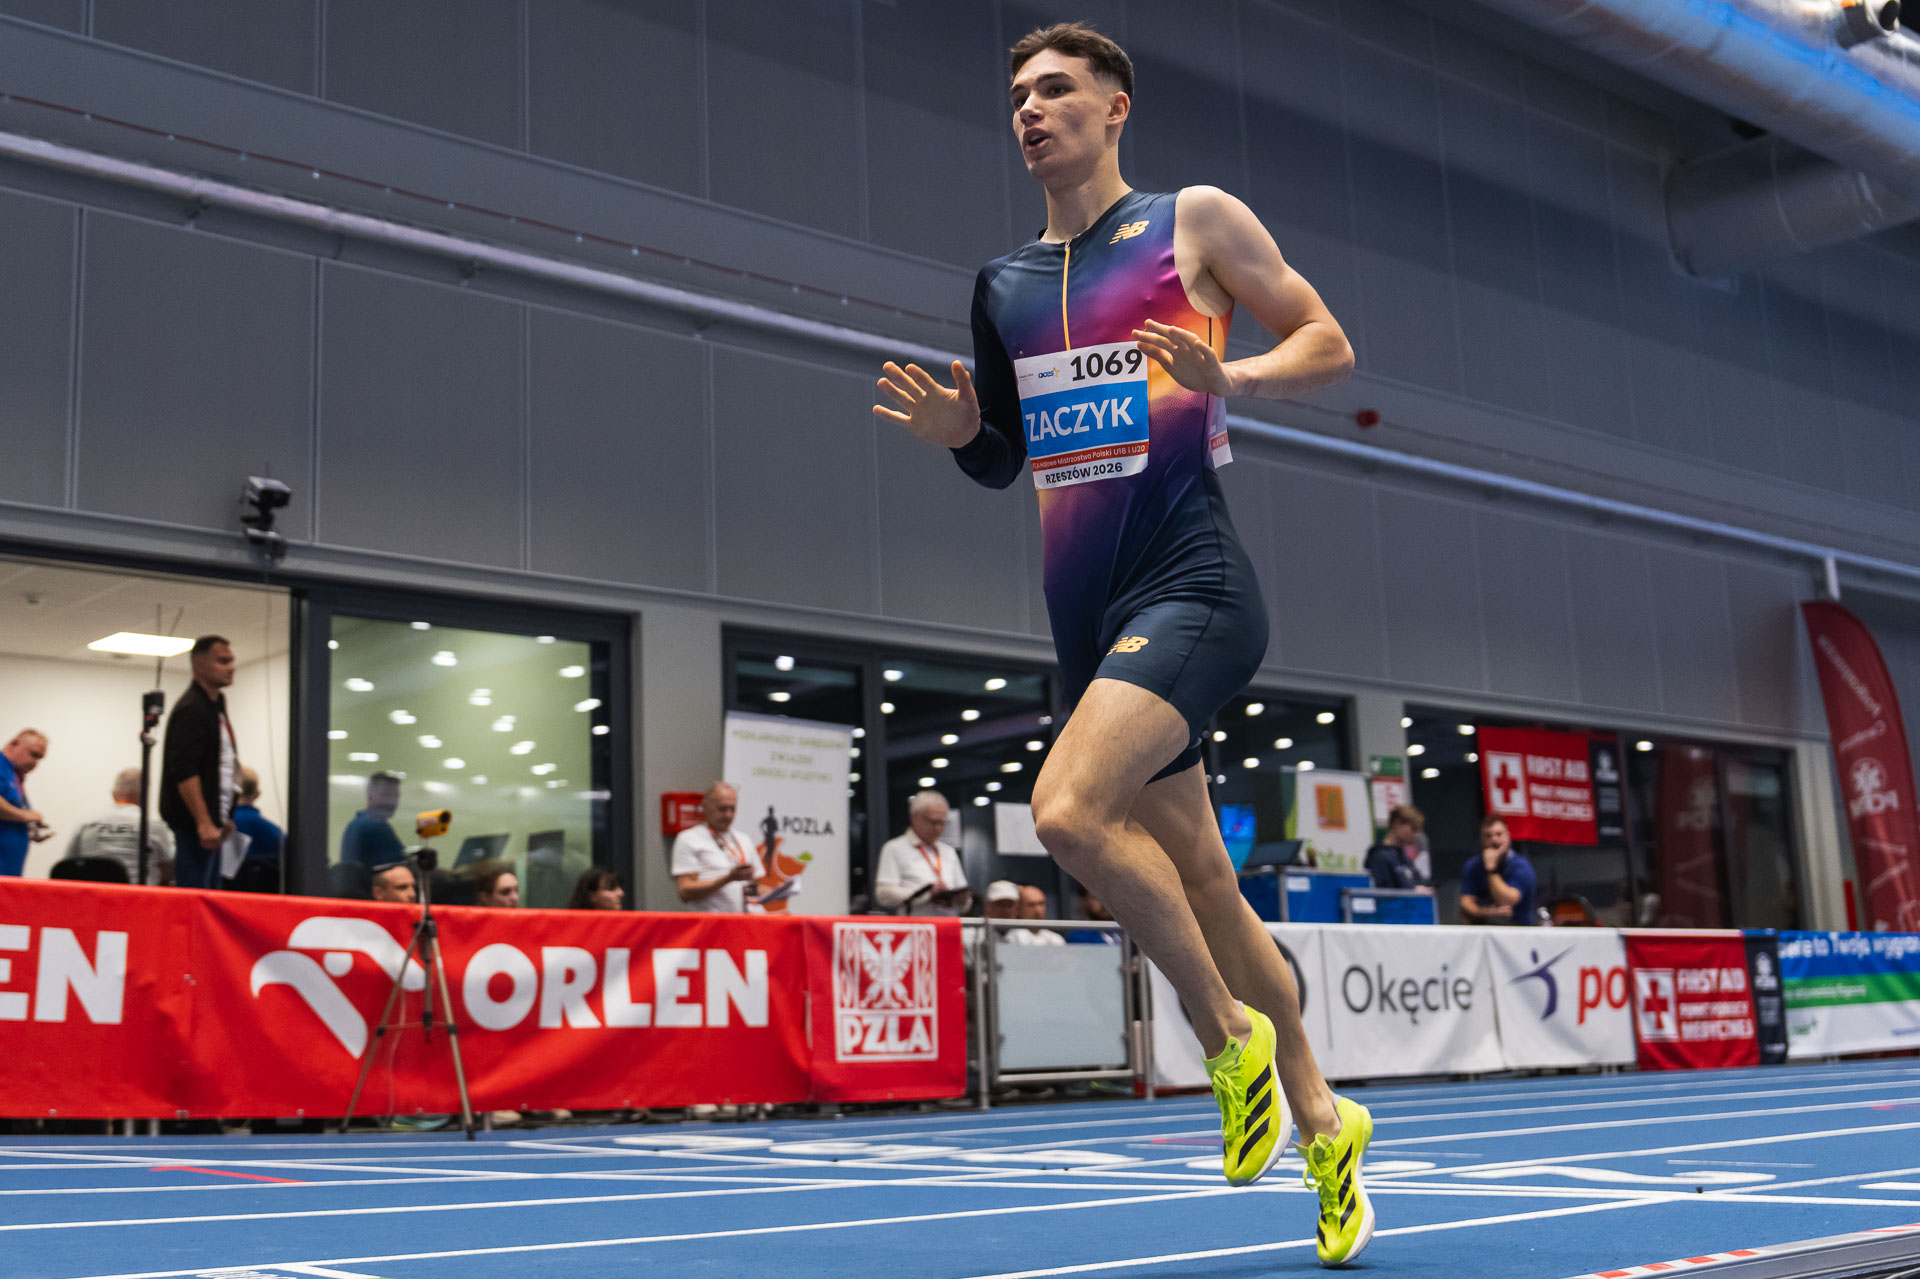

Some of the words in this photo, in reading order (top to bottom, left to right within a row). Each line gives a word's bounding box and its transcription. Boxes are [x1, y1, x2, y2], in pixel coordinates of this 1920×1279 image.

[1070, 348, 1143, 381] 1069
[1025, 397, 1134, 442] ZACZYK
[1058, 452, 1092, 465] Mistrzostwa
[1092, 448, 1112, 459] Polski
[1114, 447, 1126, 456] U18
[1132, 444, 1146, 453] U20
[1045, 466, 1091, 485] RZESZÓW
[1093, 462, 1124, 476] 2026
[782, 816, 835, 837] POZLA
[463, 942, 769, 1032] ORLEN
[1341, 962, 1474, 1025] Okęcie
[842, 1015, 932, 1053] PZLA
